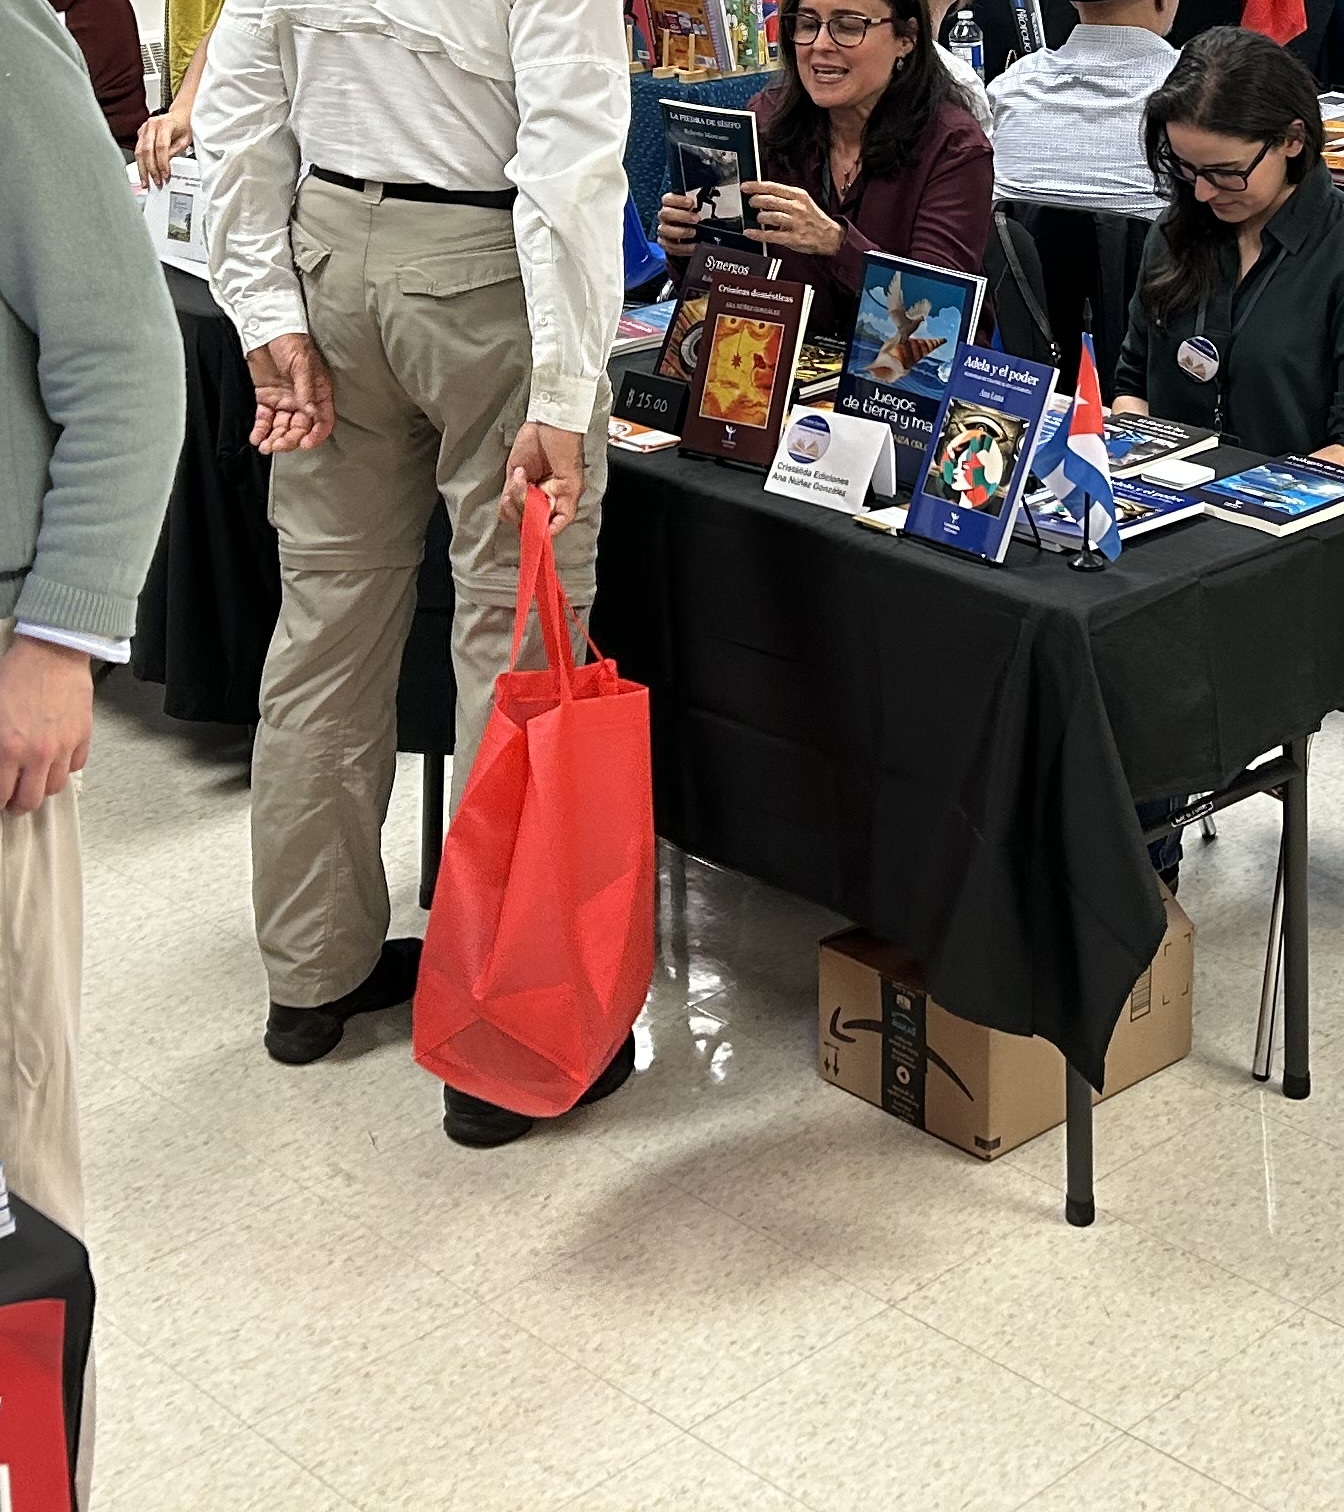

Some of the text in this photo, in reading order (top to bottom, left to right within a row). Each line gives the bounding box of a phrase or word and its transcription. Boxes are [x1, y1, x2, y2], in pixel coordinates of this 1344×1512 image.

[705, 255, 750, 276] Synergos
[718, 284, 750, 297] Crónicas
[963, 356, 990, 373] Adela
[990, 365, 999, 377] y
[999, 364, 1009, 377] el
[1008, 369, 1040, 387] poder
[636, 391, 669, 414] 15.00
[868, 387, 918, 413] Juegos
[842, 394, 934, 434] de tierra y ma
[771, 473, 787, 484] Ana
